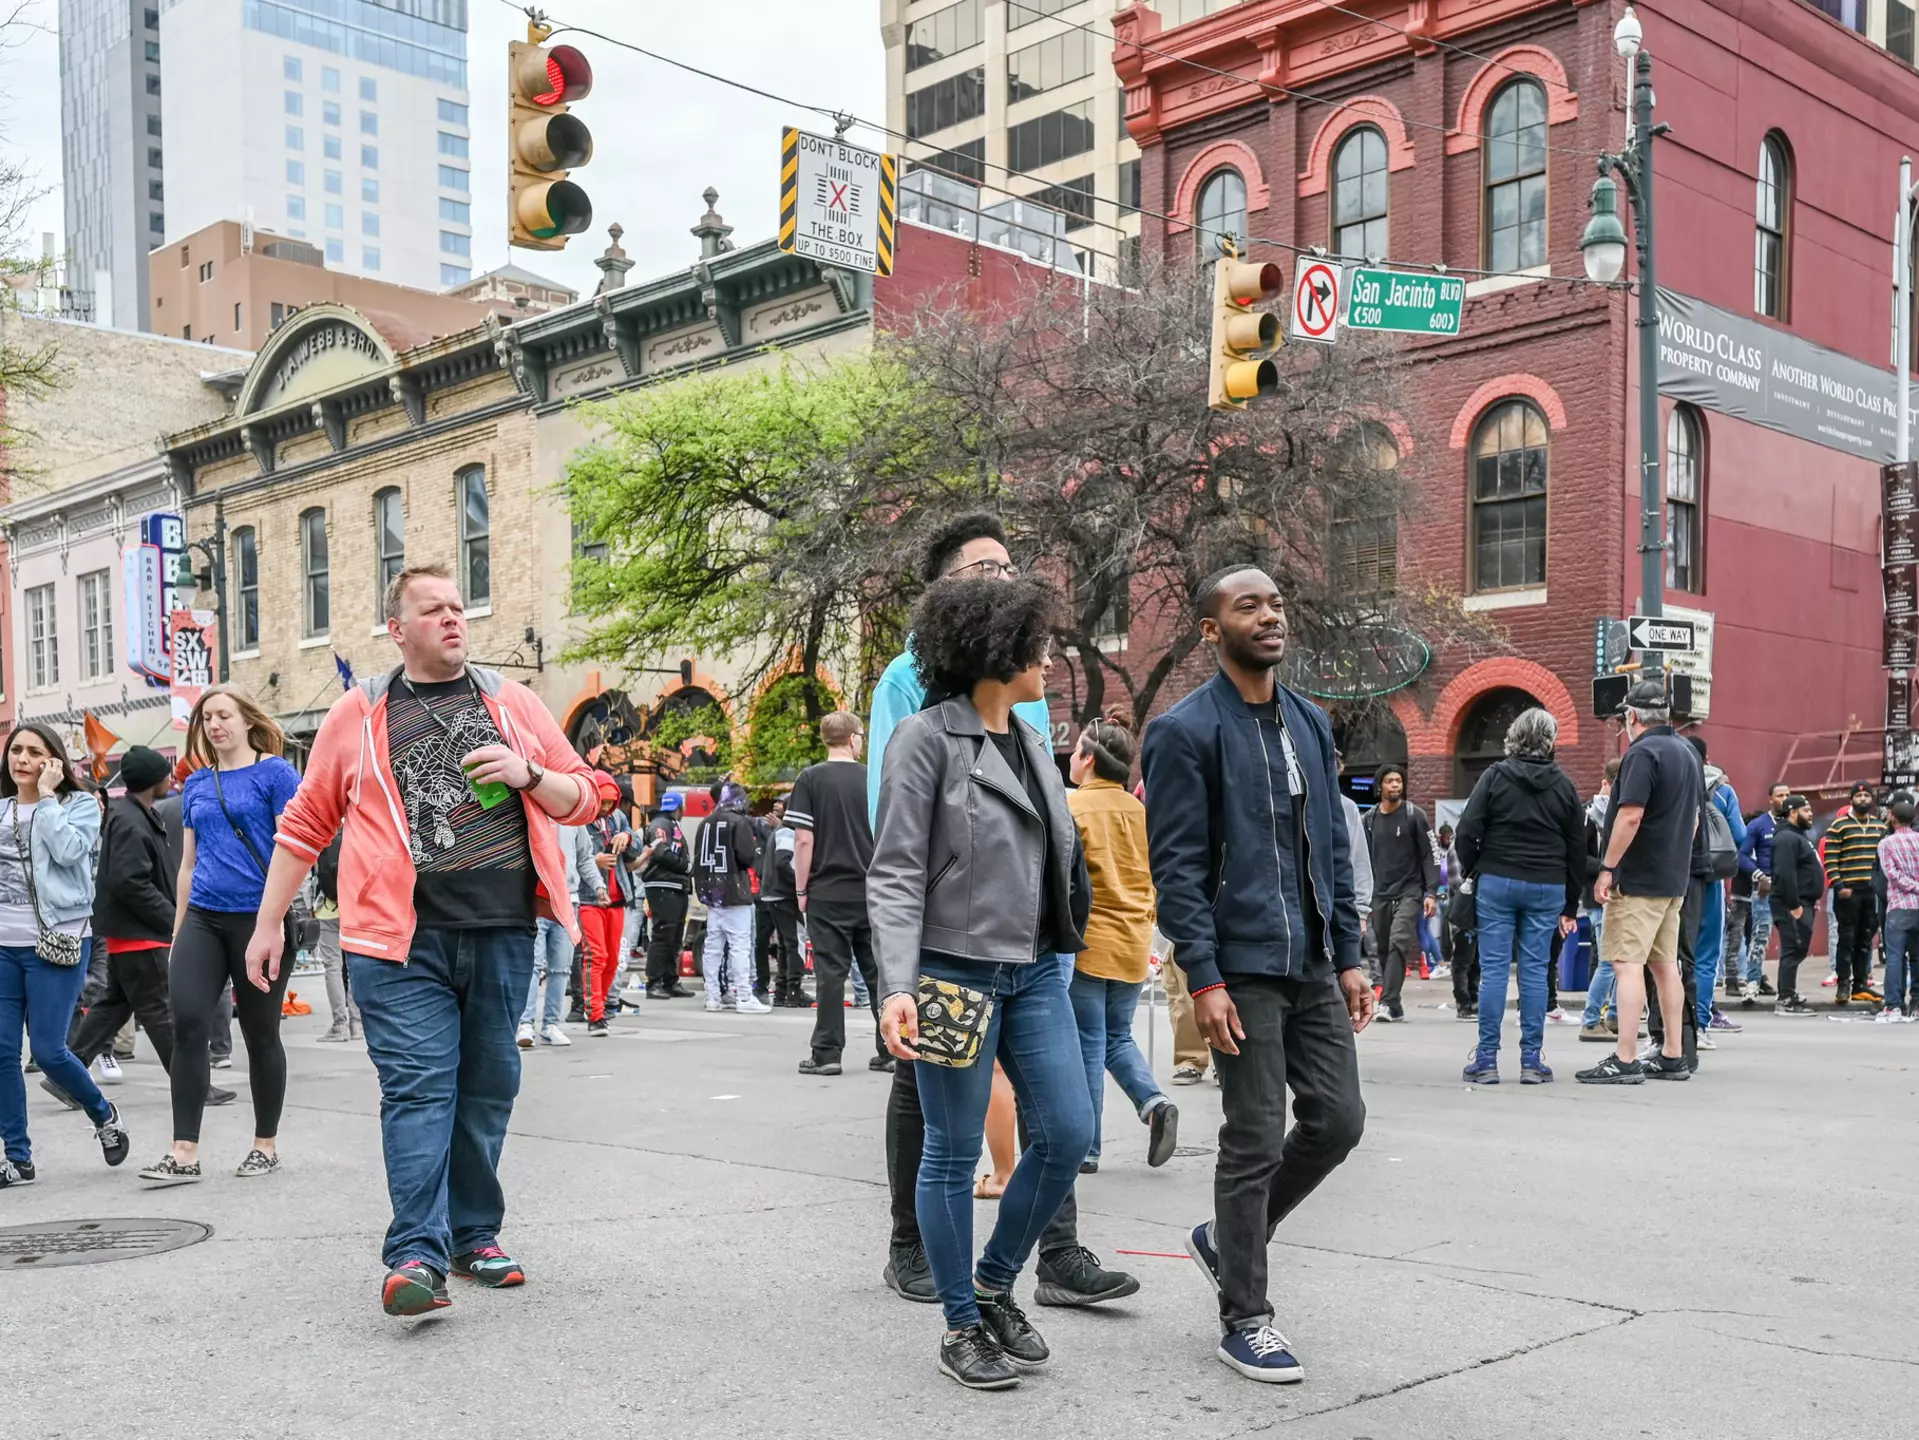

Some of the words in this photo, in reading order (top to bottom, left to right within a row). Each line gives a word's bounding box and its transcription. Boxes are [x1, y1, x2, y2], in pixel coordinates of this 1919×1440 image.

[839, 147, 878, 172] BLOCK
[811, 221, 834, 240] THE
[840, 229, 863, 247] BOX
[798, 239, 810, 251] UP
[815, 243, 826, 256] TO
[829, 247, 852, 263] $500
[855, 254, 874, 269] FINE
[1353, 274, 1380, 305] San
[1385, 277, 1436, 309] Jacinto
[1440, 282, 1462, 301] BLVD
[299, 328, 334, 361] WEBB
[339, 327, 348, 346] &
[1660, 345, 1713, 376] PROPERTY
[1716, 364, 1760, 392] COMPANY
[1772, 358, 1819, 392] ANOTHER
[1820, 374, 1854, 403] WORLD
[1856, 387, 1881, 413] CLASS
[145, 557, 153, 582] BAR
[146, 594, 156, 655] KITCHEN
[1649, 628, 1667, 640] ONE
[1669, 629, 1689, 641] WAY
[173, 631, 202, 651] SX
[173, 651, 208, 670] SW
[700, 821, 728, 873] 45
